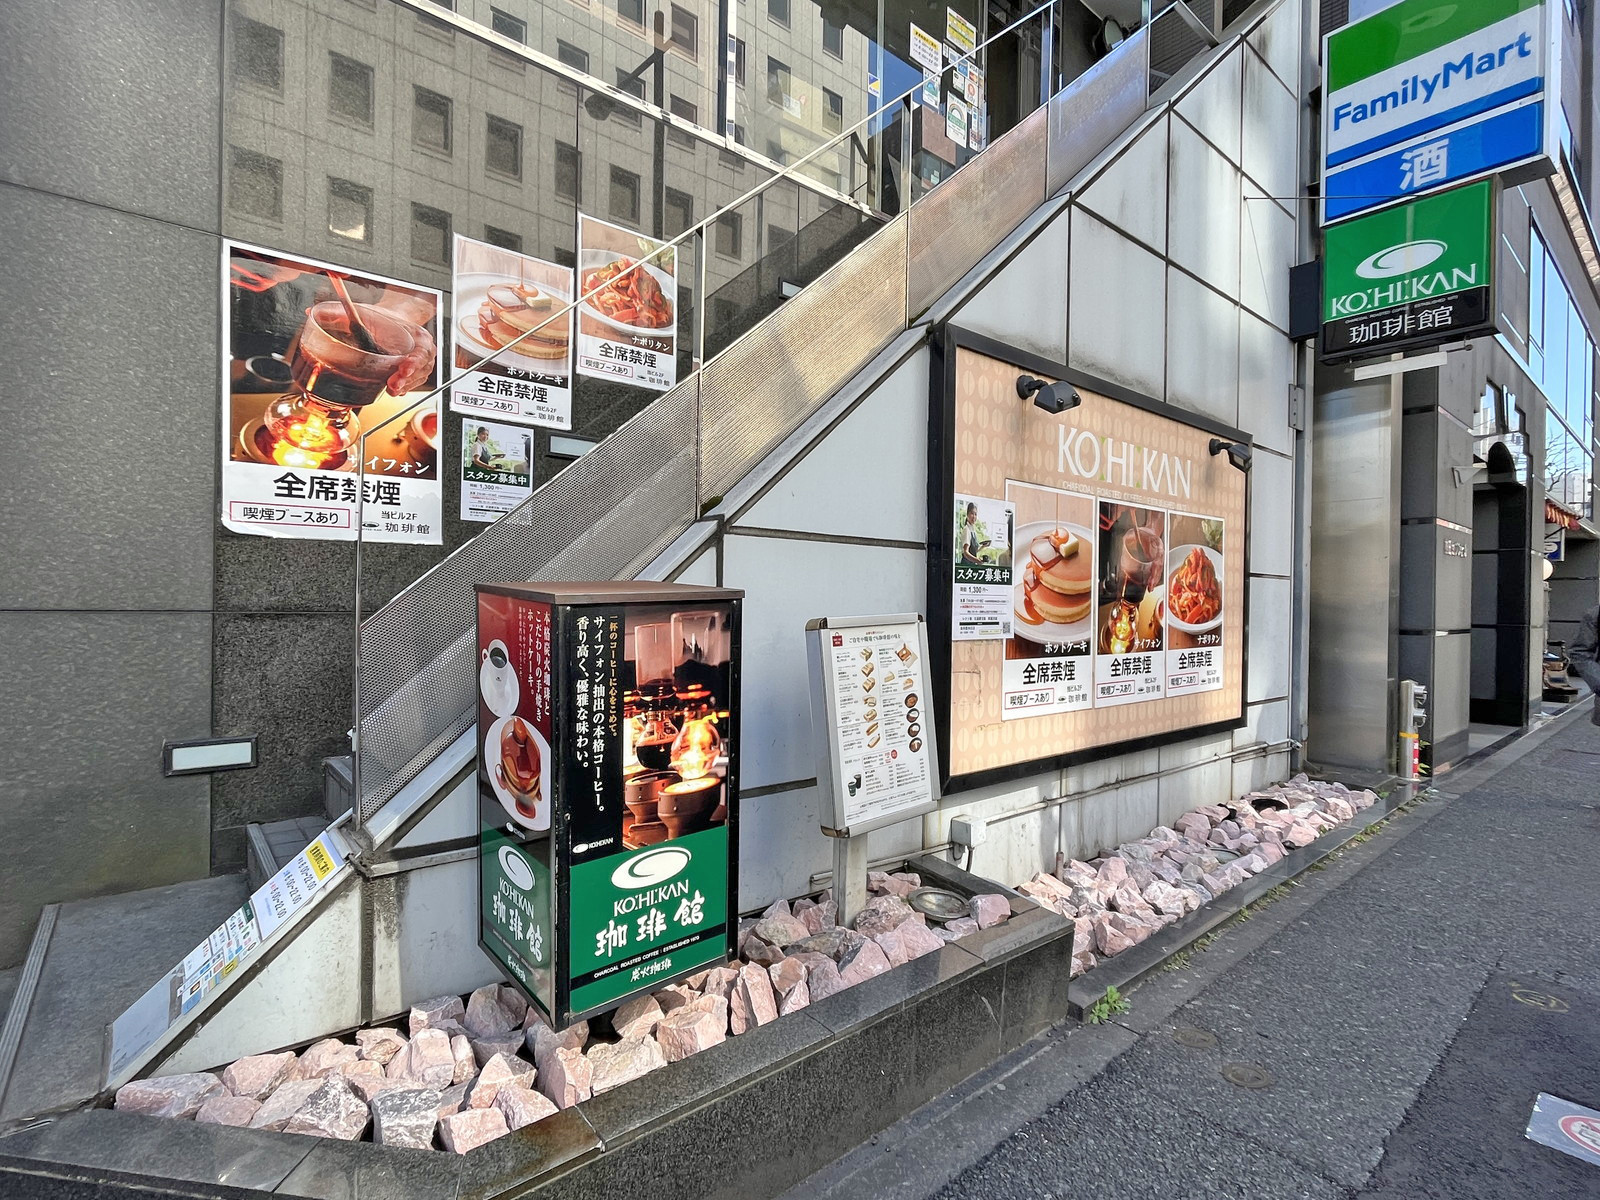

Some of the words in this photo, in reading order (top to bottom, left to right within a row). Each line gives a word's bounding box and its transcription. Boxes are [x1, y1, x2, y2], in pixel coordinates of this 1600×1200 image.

[1334, 32, 1532, 131] FamilyMart
[1400, 138, 1449, 190] 酒
[1349, 306, 1453, 344] 珈琲館
[599, 342, 657, 369] 全席禁煙
[632, 335, 670, 352] ナポリタン
[506, 366, 563, 385] ホットケーキ
[585, 359, 629, 375] 喫煙ブースあり
[477, 376, 548, 403] 全席禁煙
[461, 395, 514, 412] 喫煙ブースあり
[273, 472, 401, 506] 全席禁煙
[466, 471, 527, 486] スタッフ募集中
[243, 506, 339, 524] 喫煙ブースあり
[381, 510, 418, 521] 当ビル2F
[384, 522, 430, 534] 珈琲館
[956, 568, 1010, 582] スタッフ募集中
[1045, 641, 1087, 654] ホットケーキ
[1134, 638, 1161, 649] サイフォン
[1197, 634, 1220, 645] ナポリタン
[535, 610, 543, 722] こだわりの手焼き
[543, 611, 551, 715] 本格炭火珈琲と
[1110, 655, 1151, 677] 全席禁煙
[1178, 651, 1212, 669] 全席禁煙
[608, 615, 619, 737] 一杯のコーヒーに心をこめて。
[1023, 660, 1075, 685] 全席禁煙
[576, 615, 590, 768] 香り高く、優雅な味わい。
[1010, 693, 1050, 706] 喫煙ブースあり
[592, 615, 606, 812] サイフォン抽出の本格コーヒー。
[493, 891, 542, 962] 珈琲館
[594, 889, 705, 958] 珈琲館
[593, 965, 619, 979] CHARCOAL
[620, 957, 642, 969] ROASTED
[642, 950, 659, 960] COFFEE
[663, 939, 690, 953] ESTABLISHED
[630, 958, 672, 982] 炭火珈琲
